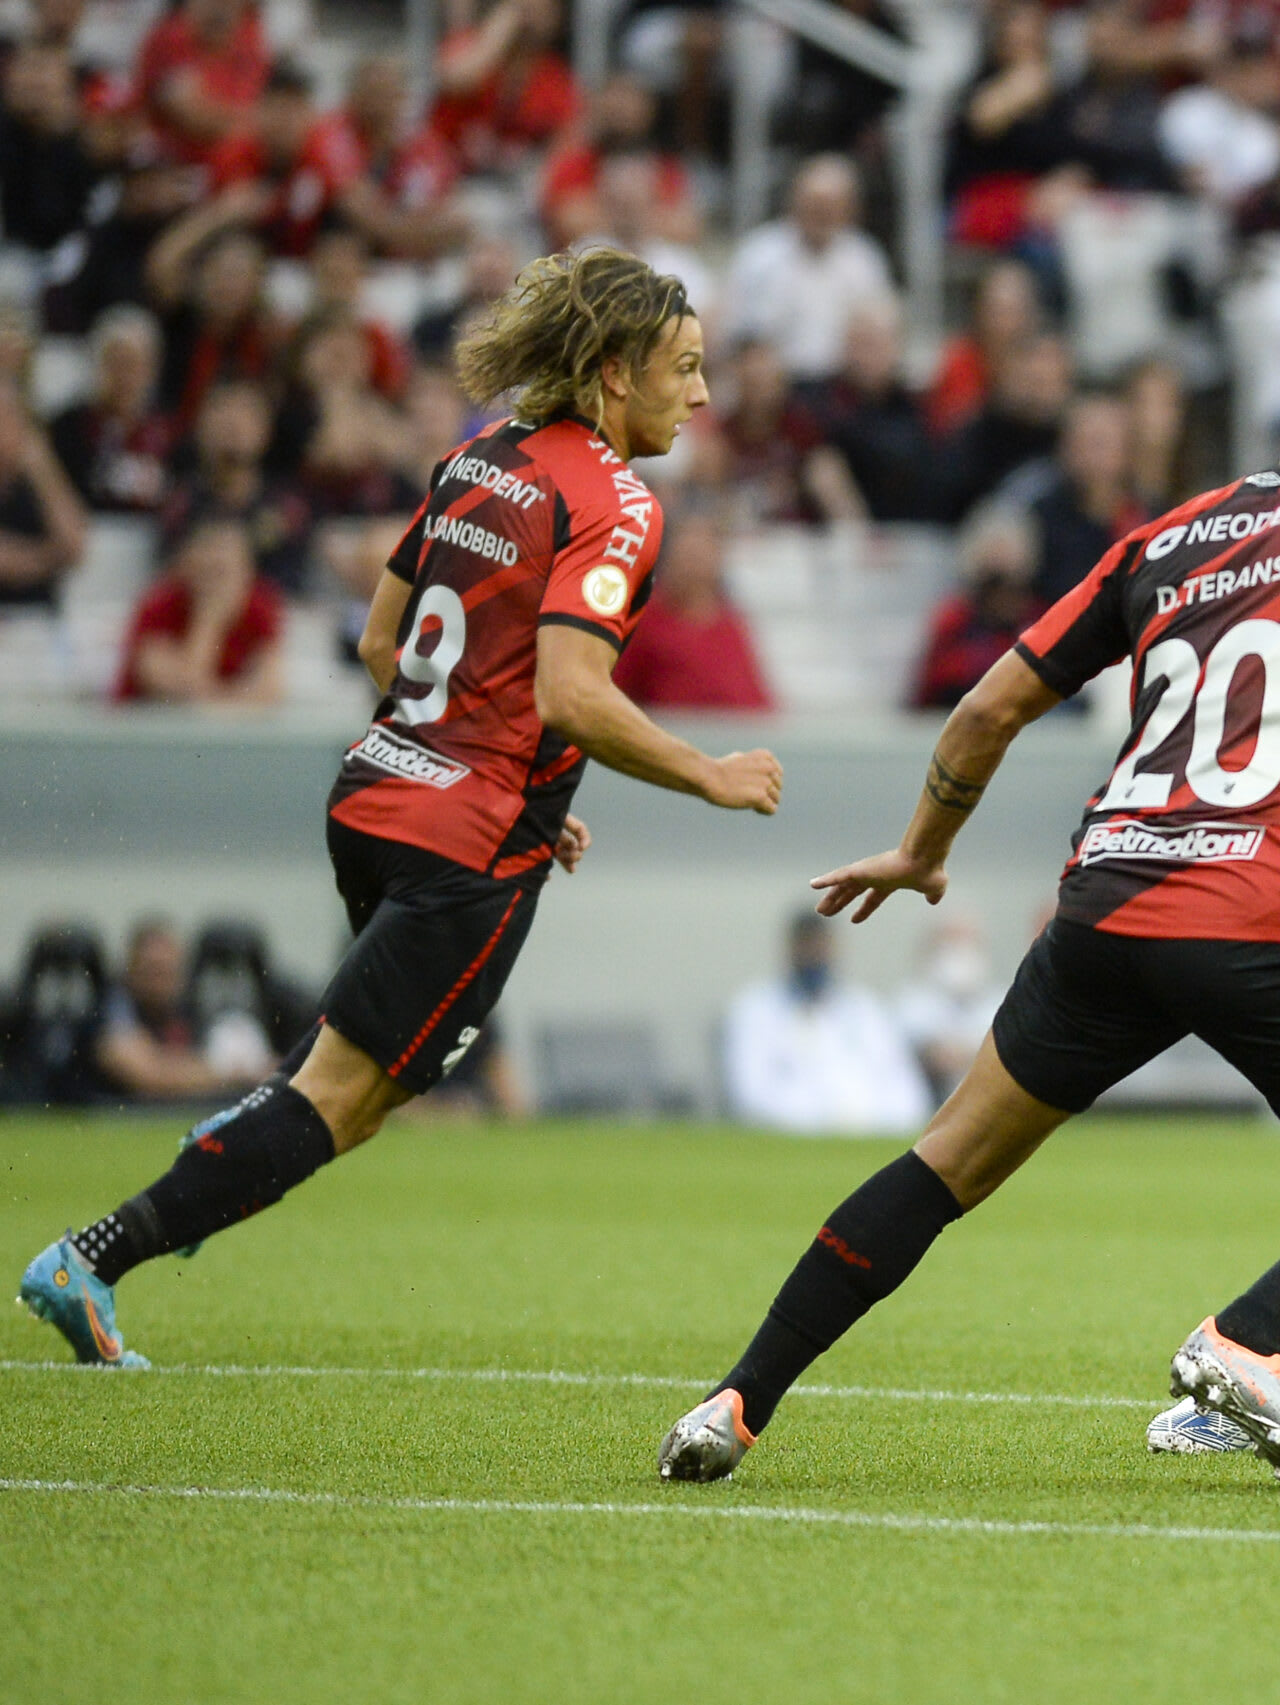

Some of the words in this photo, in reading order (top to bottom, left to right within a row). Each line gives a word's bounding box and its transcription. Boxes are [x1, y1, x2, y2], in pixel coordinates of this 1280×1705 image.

[450, 456, 540, 509] NEODENT
[390, 584, 466, 727] 9
[1085, 826, 1257, 858] Betmotion!
